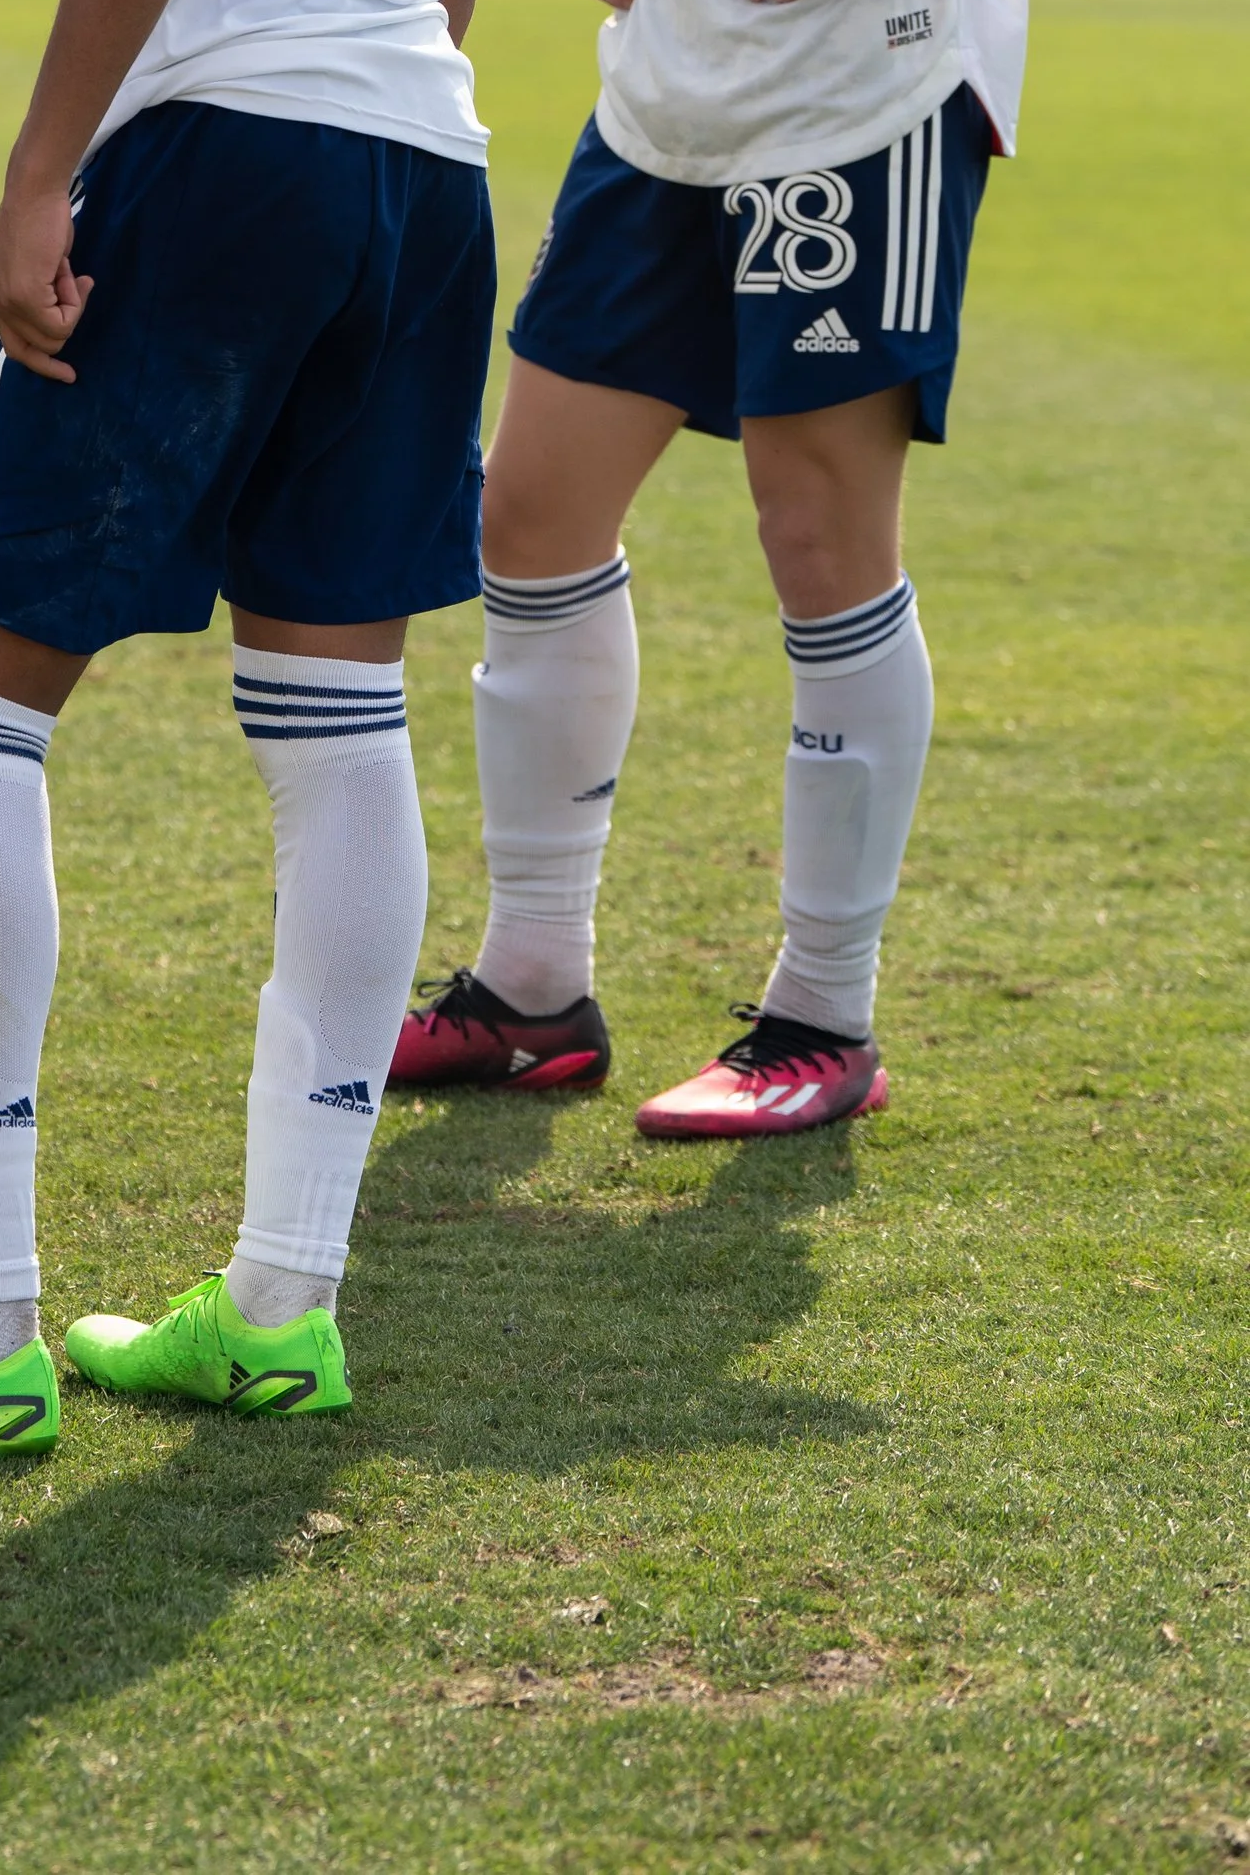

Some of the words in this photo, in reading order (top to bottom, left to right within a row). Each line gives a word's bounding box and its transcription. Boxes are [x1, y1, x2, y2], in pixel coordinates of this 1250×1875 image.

[885, 9, 932, 36] UNITE
[724, 169, 857, 294] 28
[793, 338, 860, 353] adidas
[308, 1093, 374, 1115] adidas
